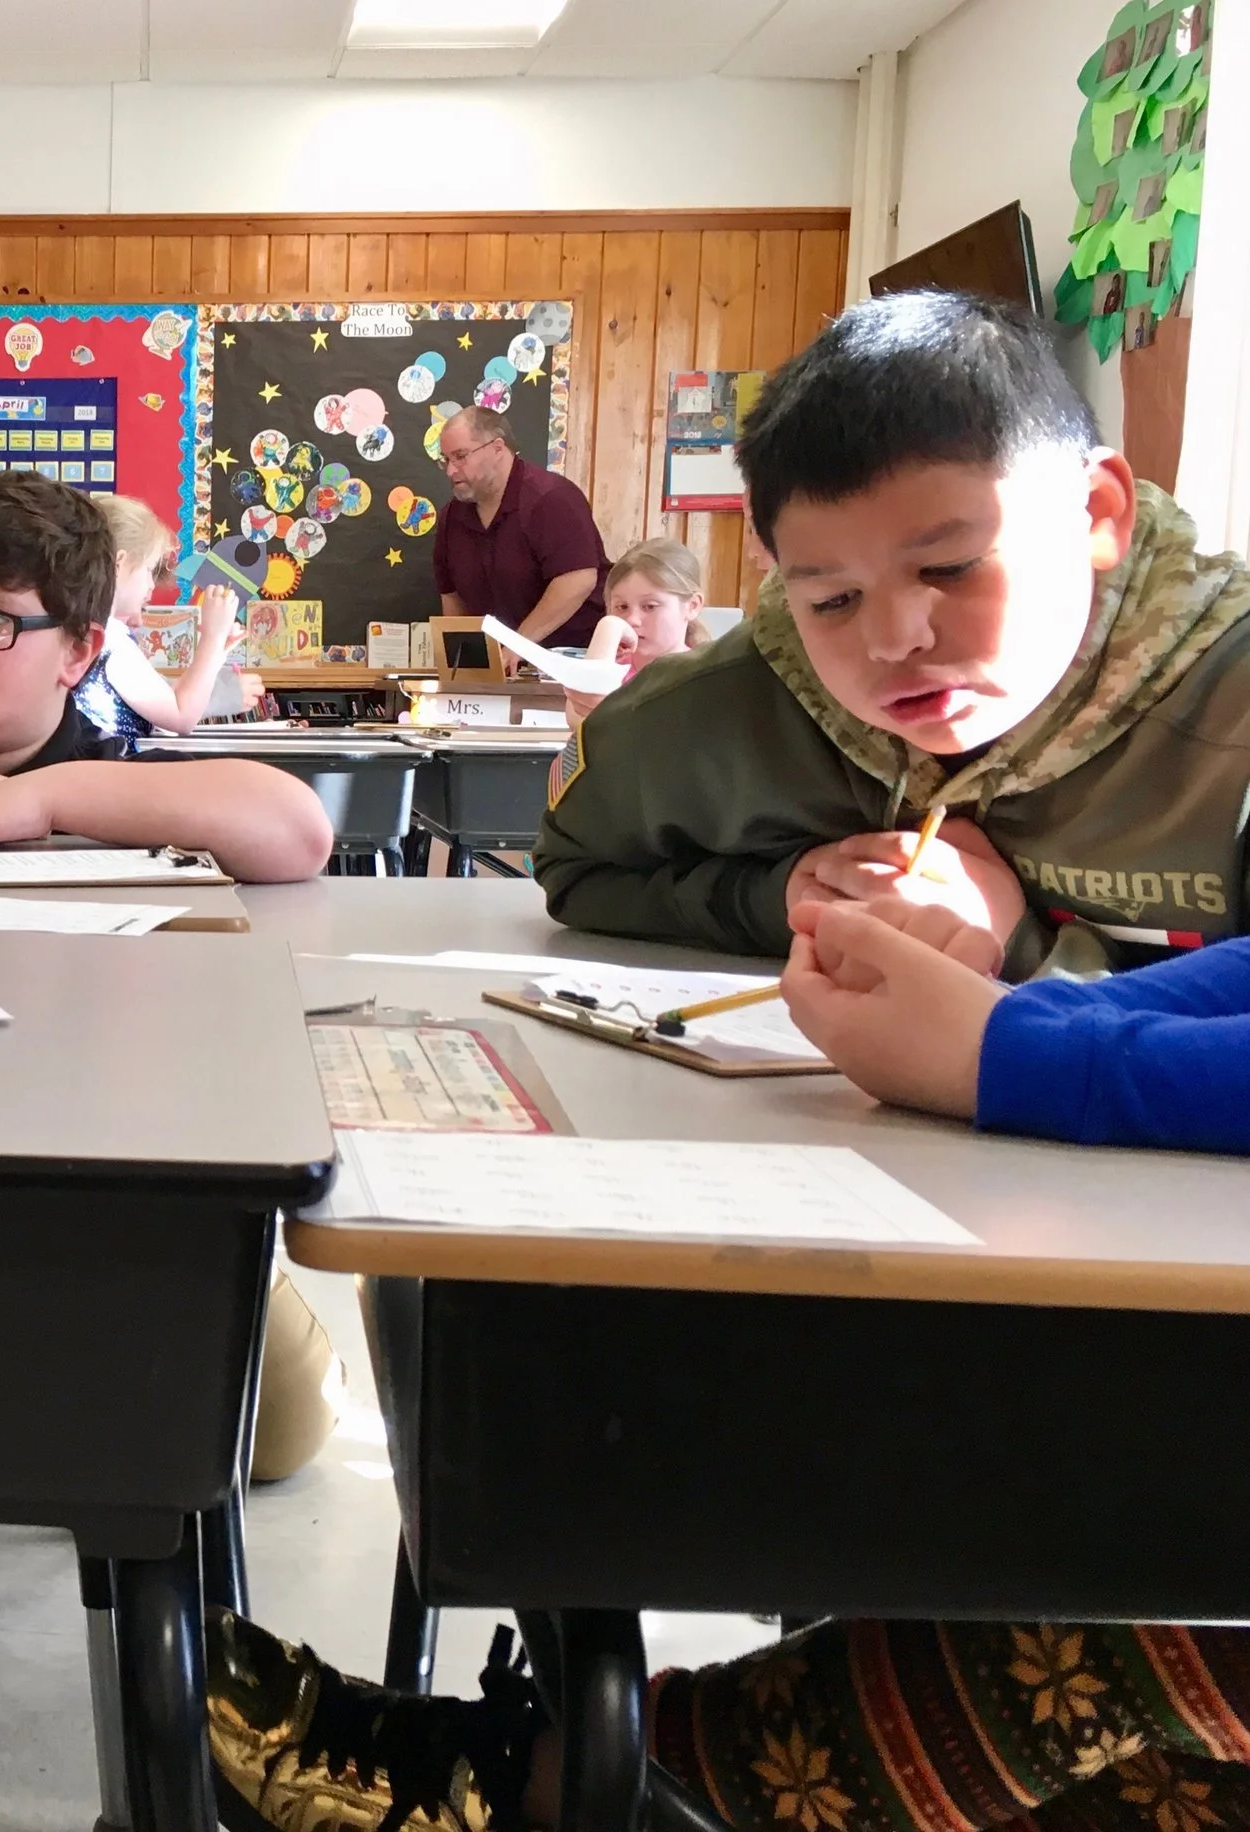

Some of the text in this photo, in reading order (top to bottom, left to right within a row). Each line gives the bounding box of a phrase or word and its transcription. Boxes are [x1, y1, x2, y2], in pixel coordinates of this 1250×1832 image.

[351, 303, 406, 317] Race To
[343, 323, 412, 336] The Moon
[10, 334, 37, 343] GREAT
[15, 342, 32, 351] JOB
[447, 699, 484, 715] Mrs.
[1013, 854, 1228, 915] PATRIOTS
